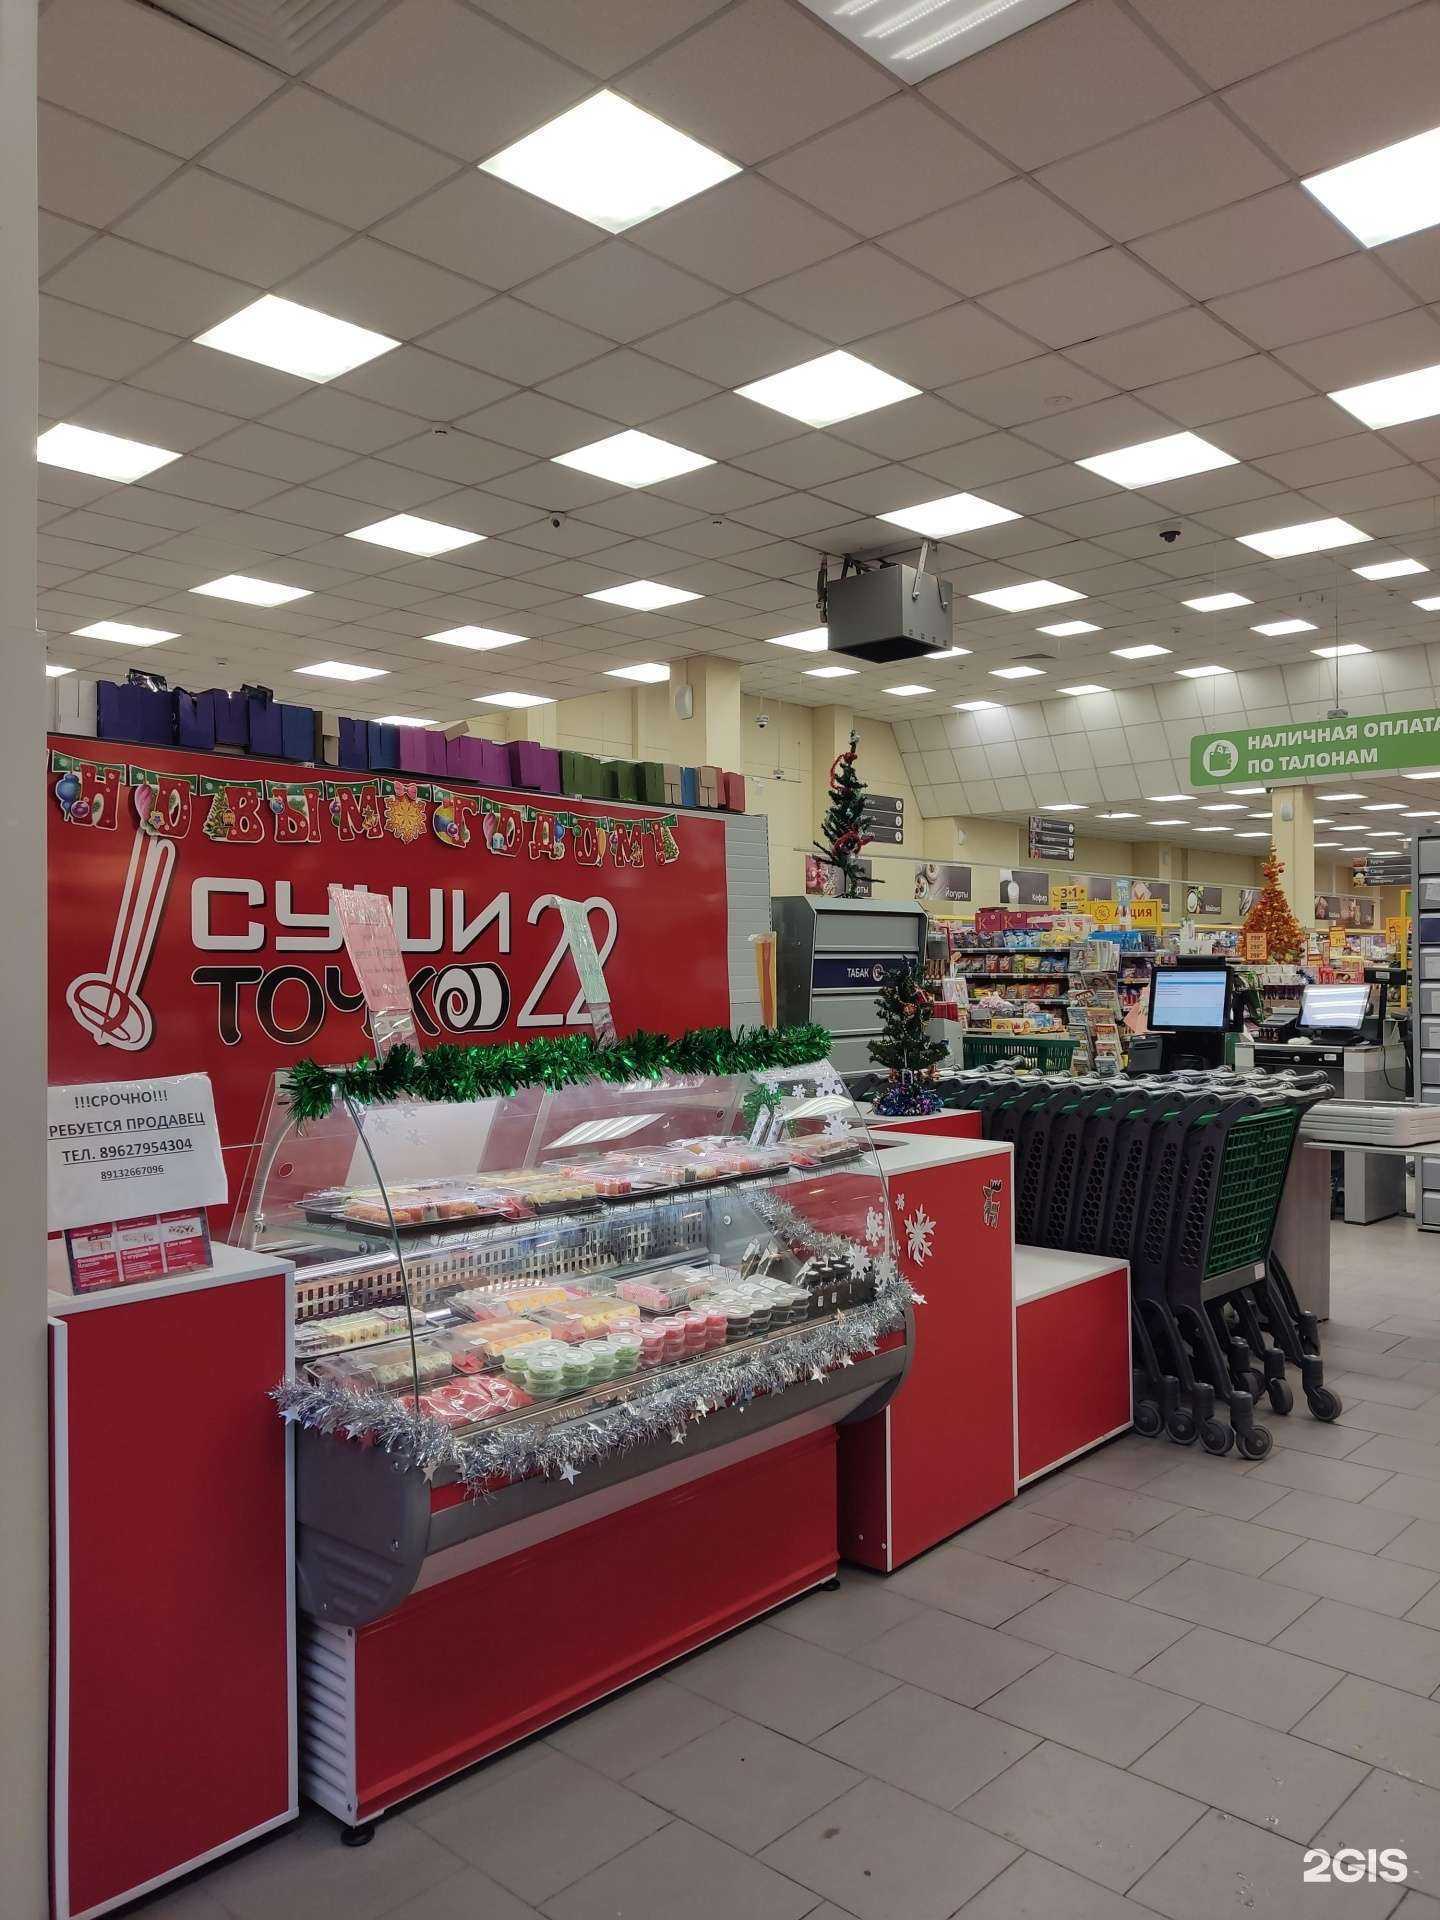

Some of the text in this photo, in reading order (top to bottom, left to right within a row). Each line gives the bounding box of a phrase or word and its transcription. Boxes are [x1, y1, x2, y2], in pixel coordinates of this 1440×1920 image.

[1247, 724, 1358, 750] НАЛИЧНАЯ
[1247, 748, 1378, 774] ПО ТАЛОНАМ
[70, 762, 383, 843] НОВЫМ
[945, 885, 969, 899] Йогурты
[191, 876, 619, 1028] СУШИ 22
[847, 967, 869, 978] ТАБАК
[74, 1090, 168, 1109] !!!СРОЧНО!!!
[48, 1112, 206, 1138] РЕБУЕТСЯ ПРОДАВЕЦ
[62, 1138, 193, 1163] ТЕЛ. 89627954304
[100, 1165, 164, 1180] 89132667096
